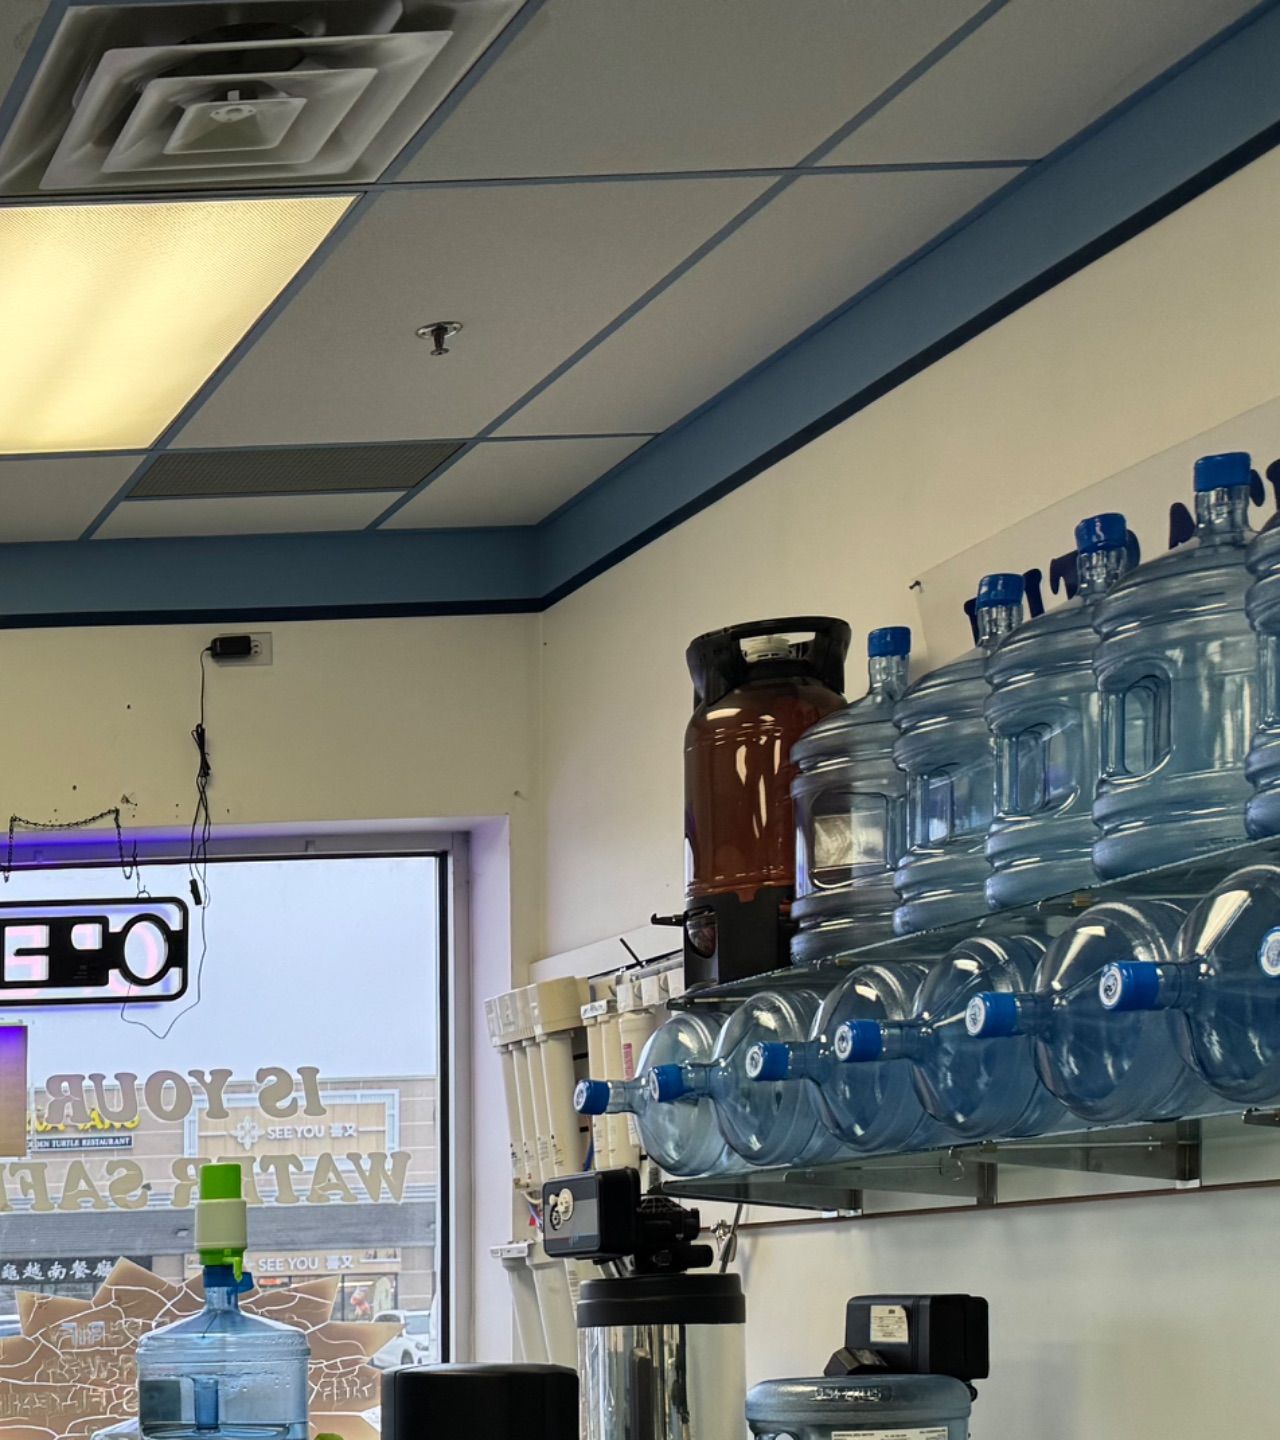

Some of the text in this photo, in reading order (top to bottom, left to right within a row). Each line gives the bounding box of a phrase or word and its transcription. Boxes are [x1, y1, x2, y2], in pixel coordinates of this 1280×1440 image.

[267, 1125, 325, 1140] SEE YOU
[258, 1257, 319, 1271] SEE YOU
